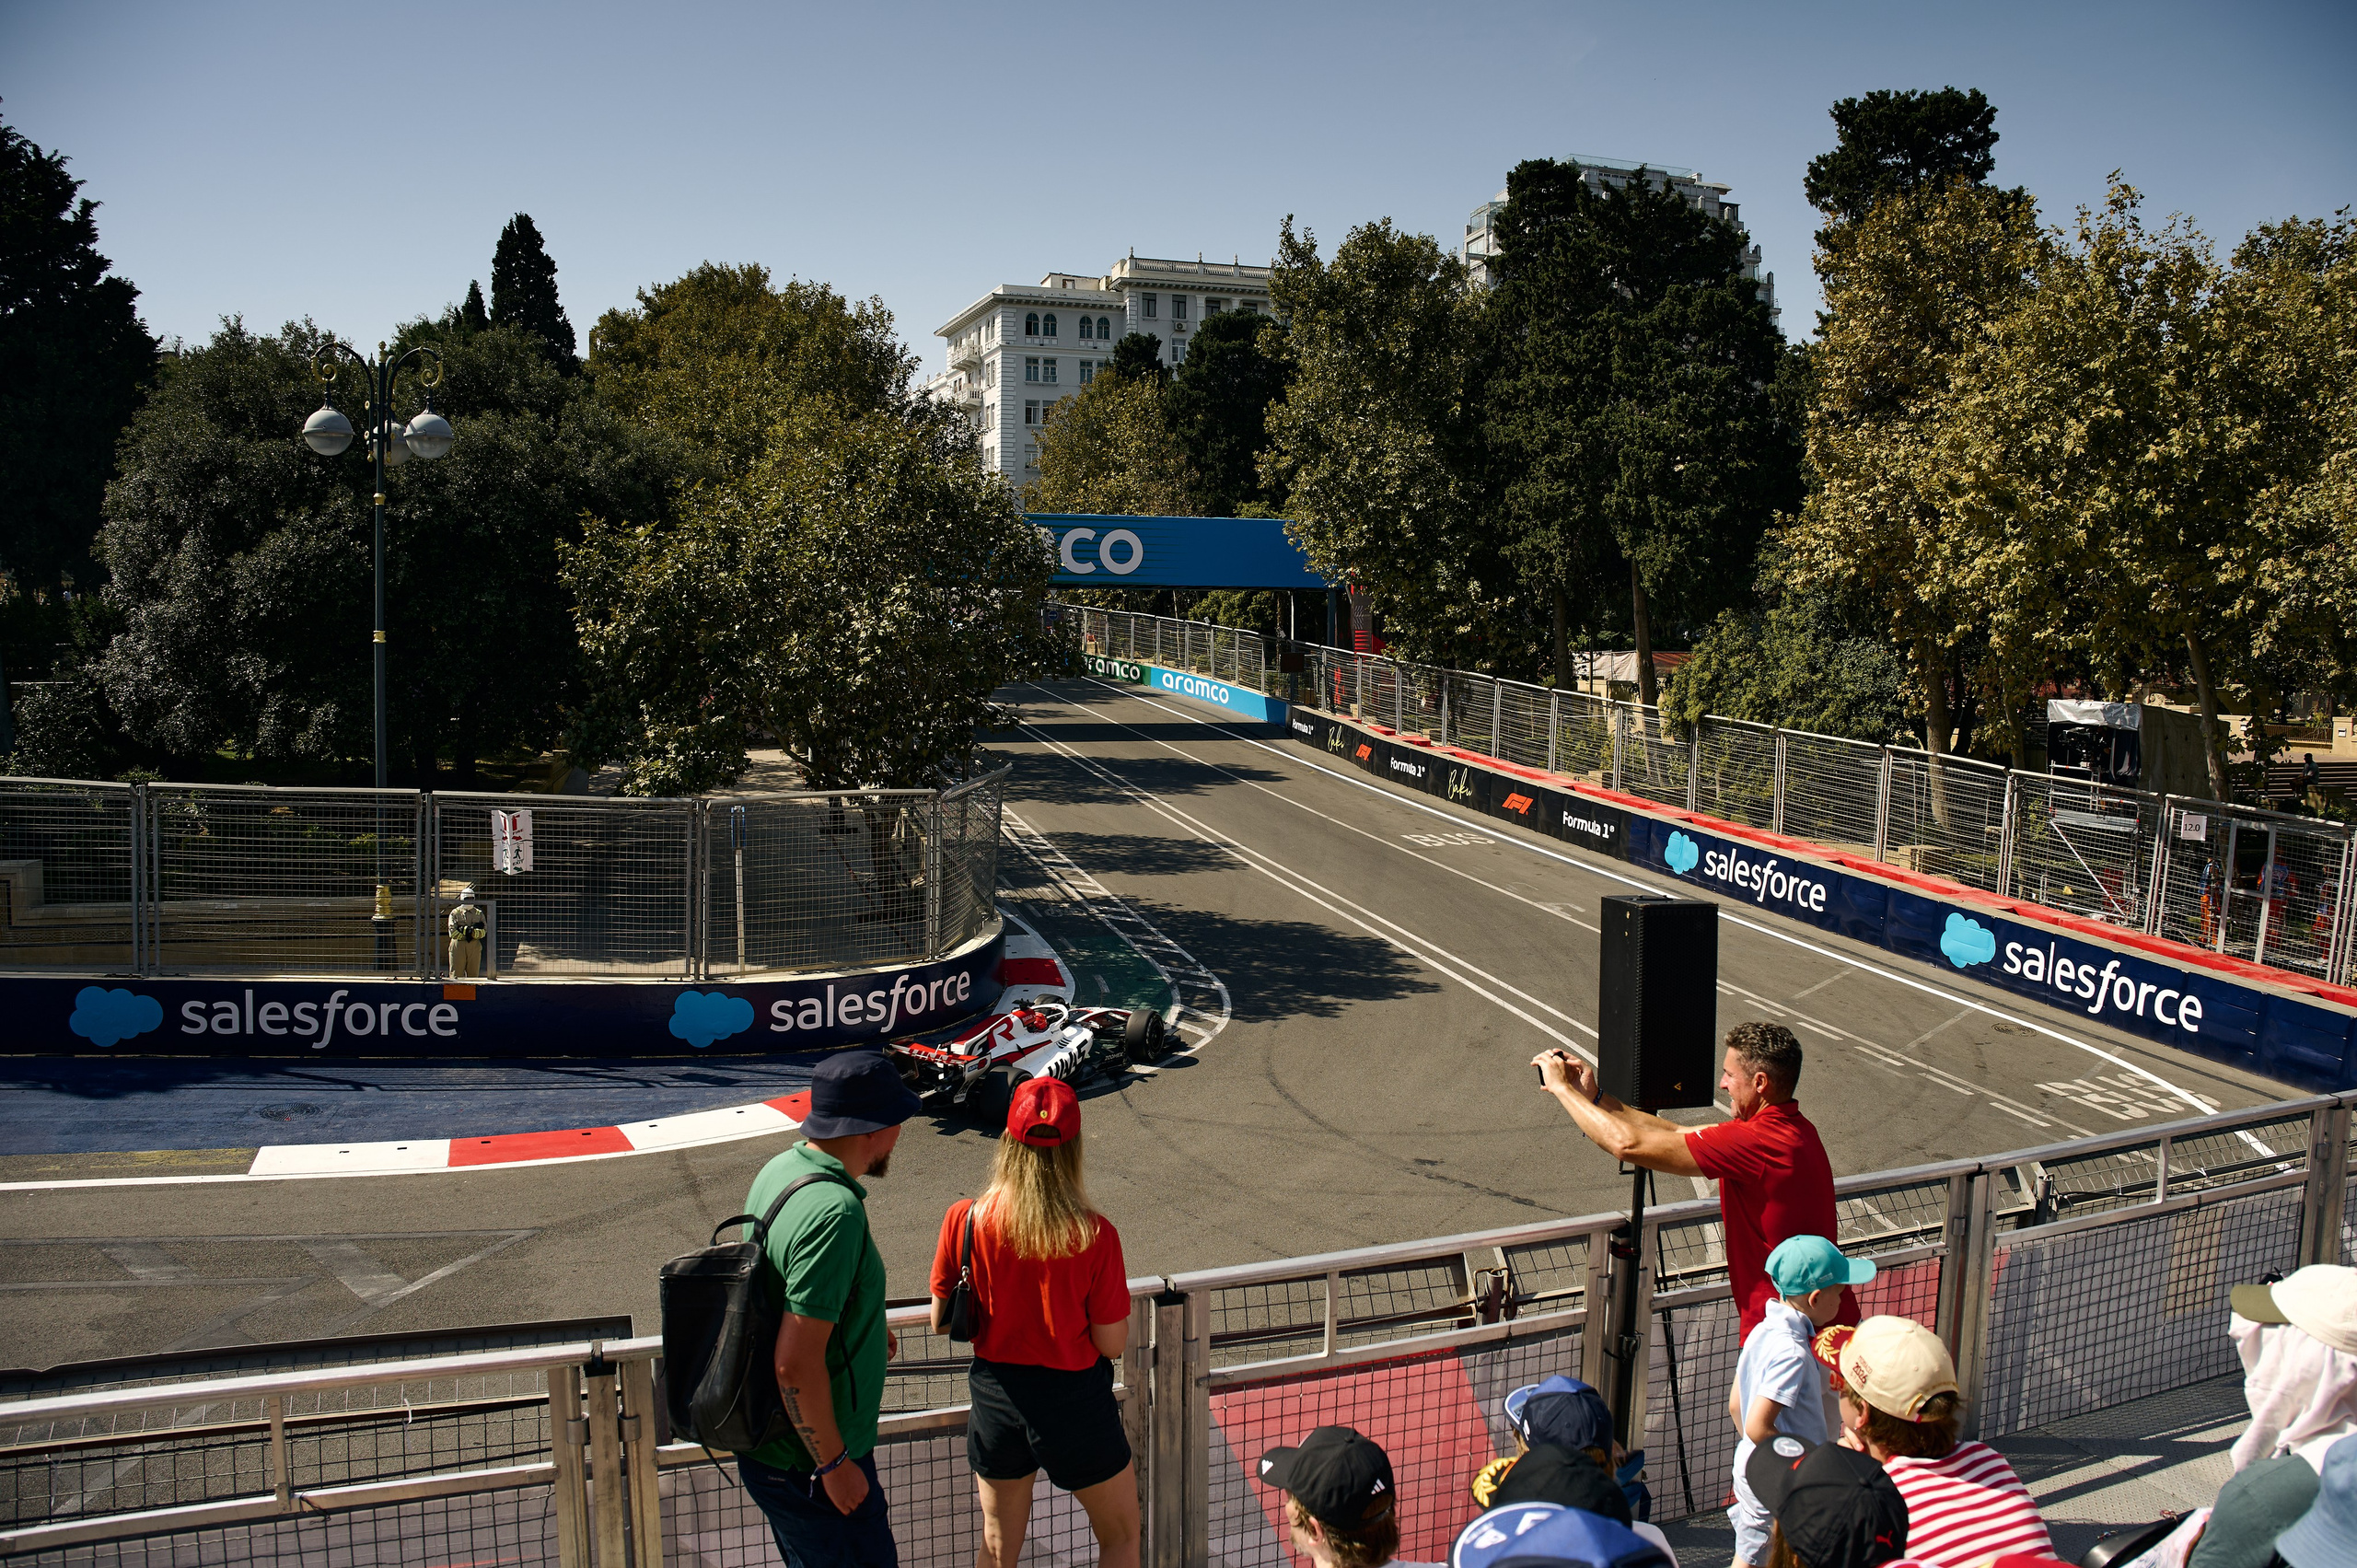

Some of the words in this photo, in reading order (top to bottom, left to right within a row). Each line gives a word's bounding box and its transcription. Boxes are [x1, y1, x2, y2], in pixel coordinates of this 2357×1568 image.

[1162, 672, 1229, 704] aramco
[1292, 718, 1308, 734] Formula
[1390, 757, 1417, 776] Formula
[1447, 767, 1473, 800] Baku
[1400, 832, 1496, 847] BUS
[1562, 810, 1601, 837] Formula
[2184, 823, 2200, 832] 12.0
[1703, 848, 1827, 912] salesforce
[770, 971, 970, 1033] salesforce
[2003, 941, 2203, 1033] salesforce
[180, 989, 459, 1049] salesforce
